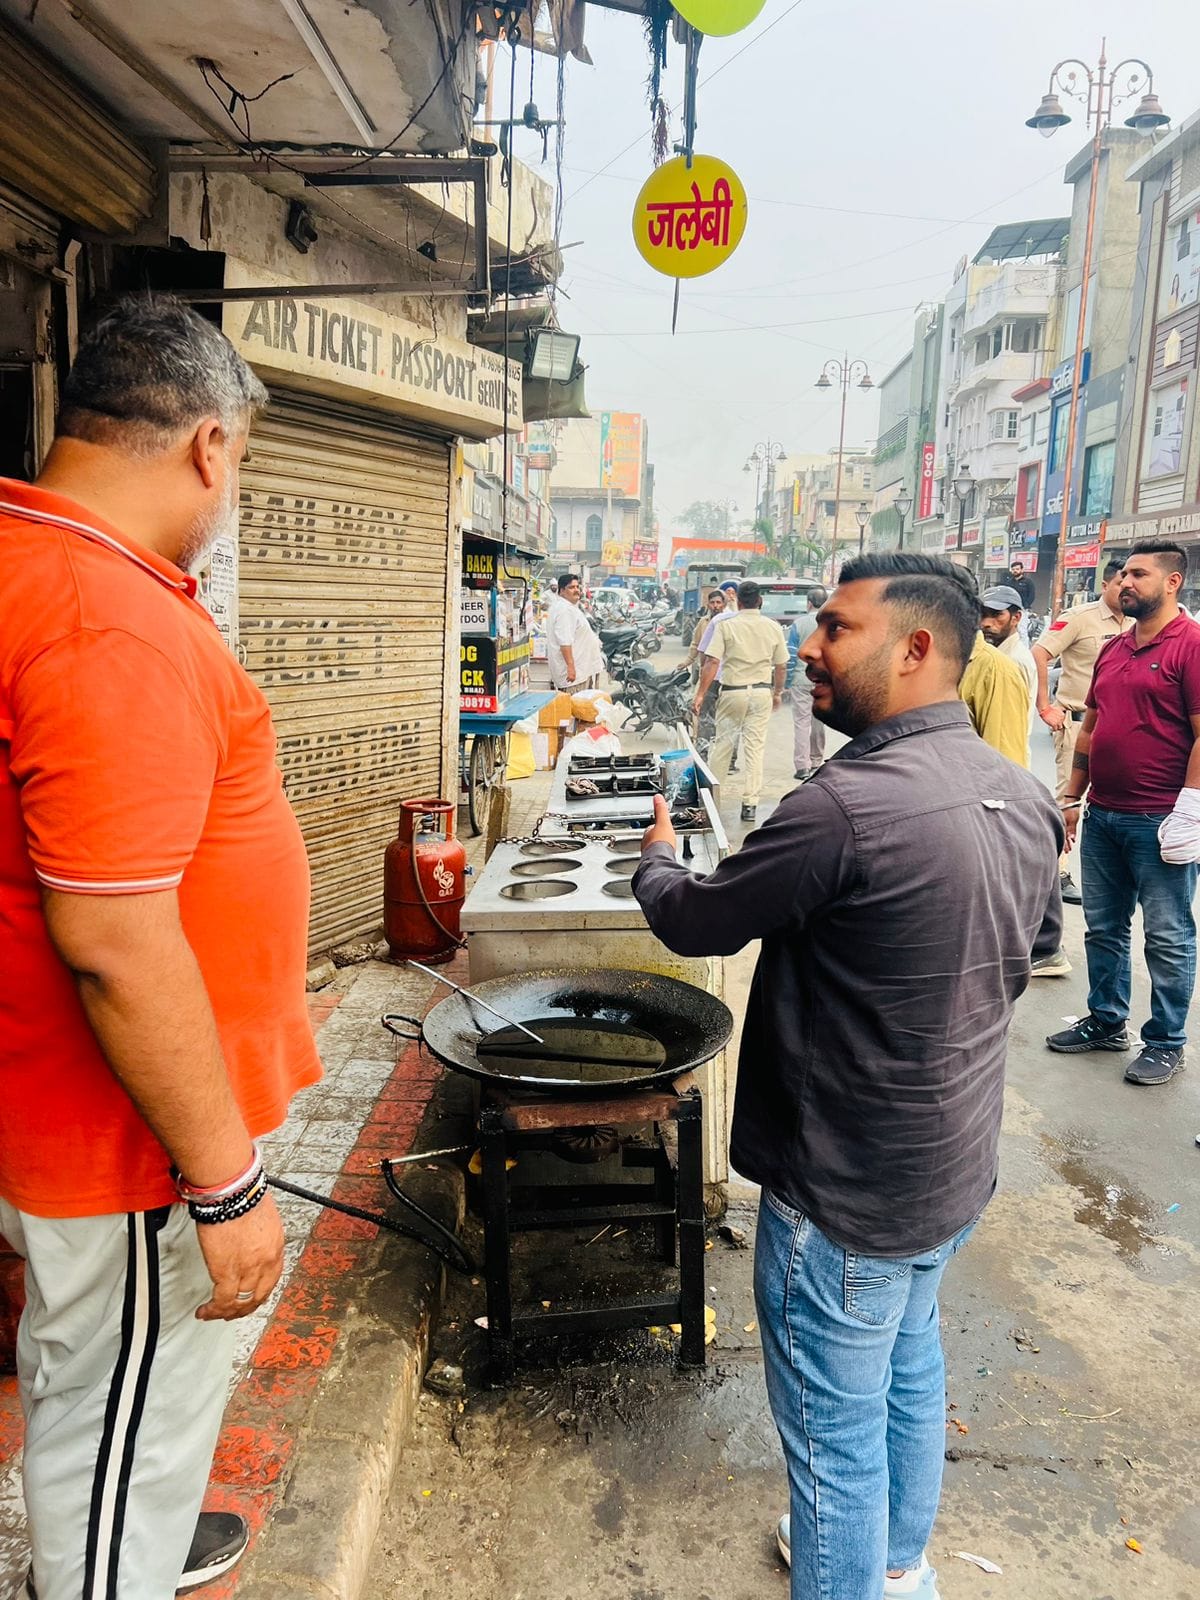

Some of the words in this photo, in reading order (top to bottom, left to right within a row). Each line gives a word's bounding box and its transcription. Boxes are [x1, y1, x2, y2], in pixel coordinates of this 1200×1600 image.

[647, 178, 733, 251] जलेबी
[241, 299, 298, 353] AIR
[304, 302, 382, 375] TICKET
[391, 333, 476, 401] PASSPORT
[478, 380, 518, 415] SERVICE
[924, 452, 934, 477] OYO
[466, 554, 494, 573] BACK
[462, 670, 485, 686] CK
